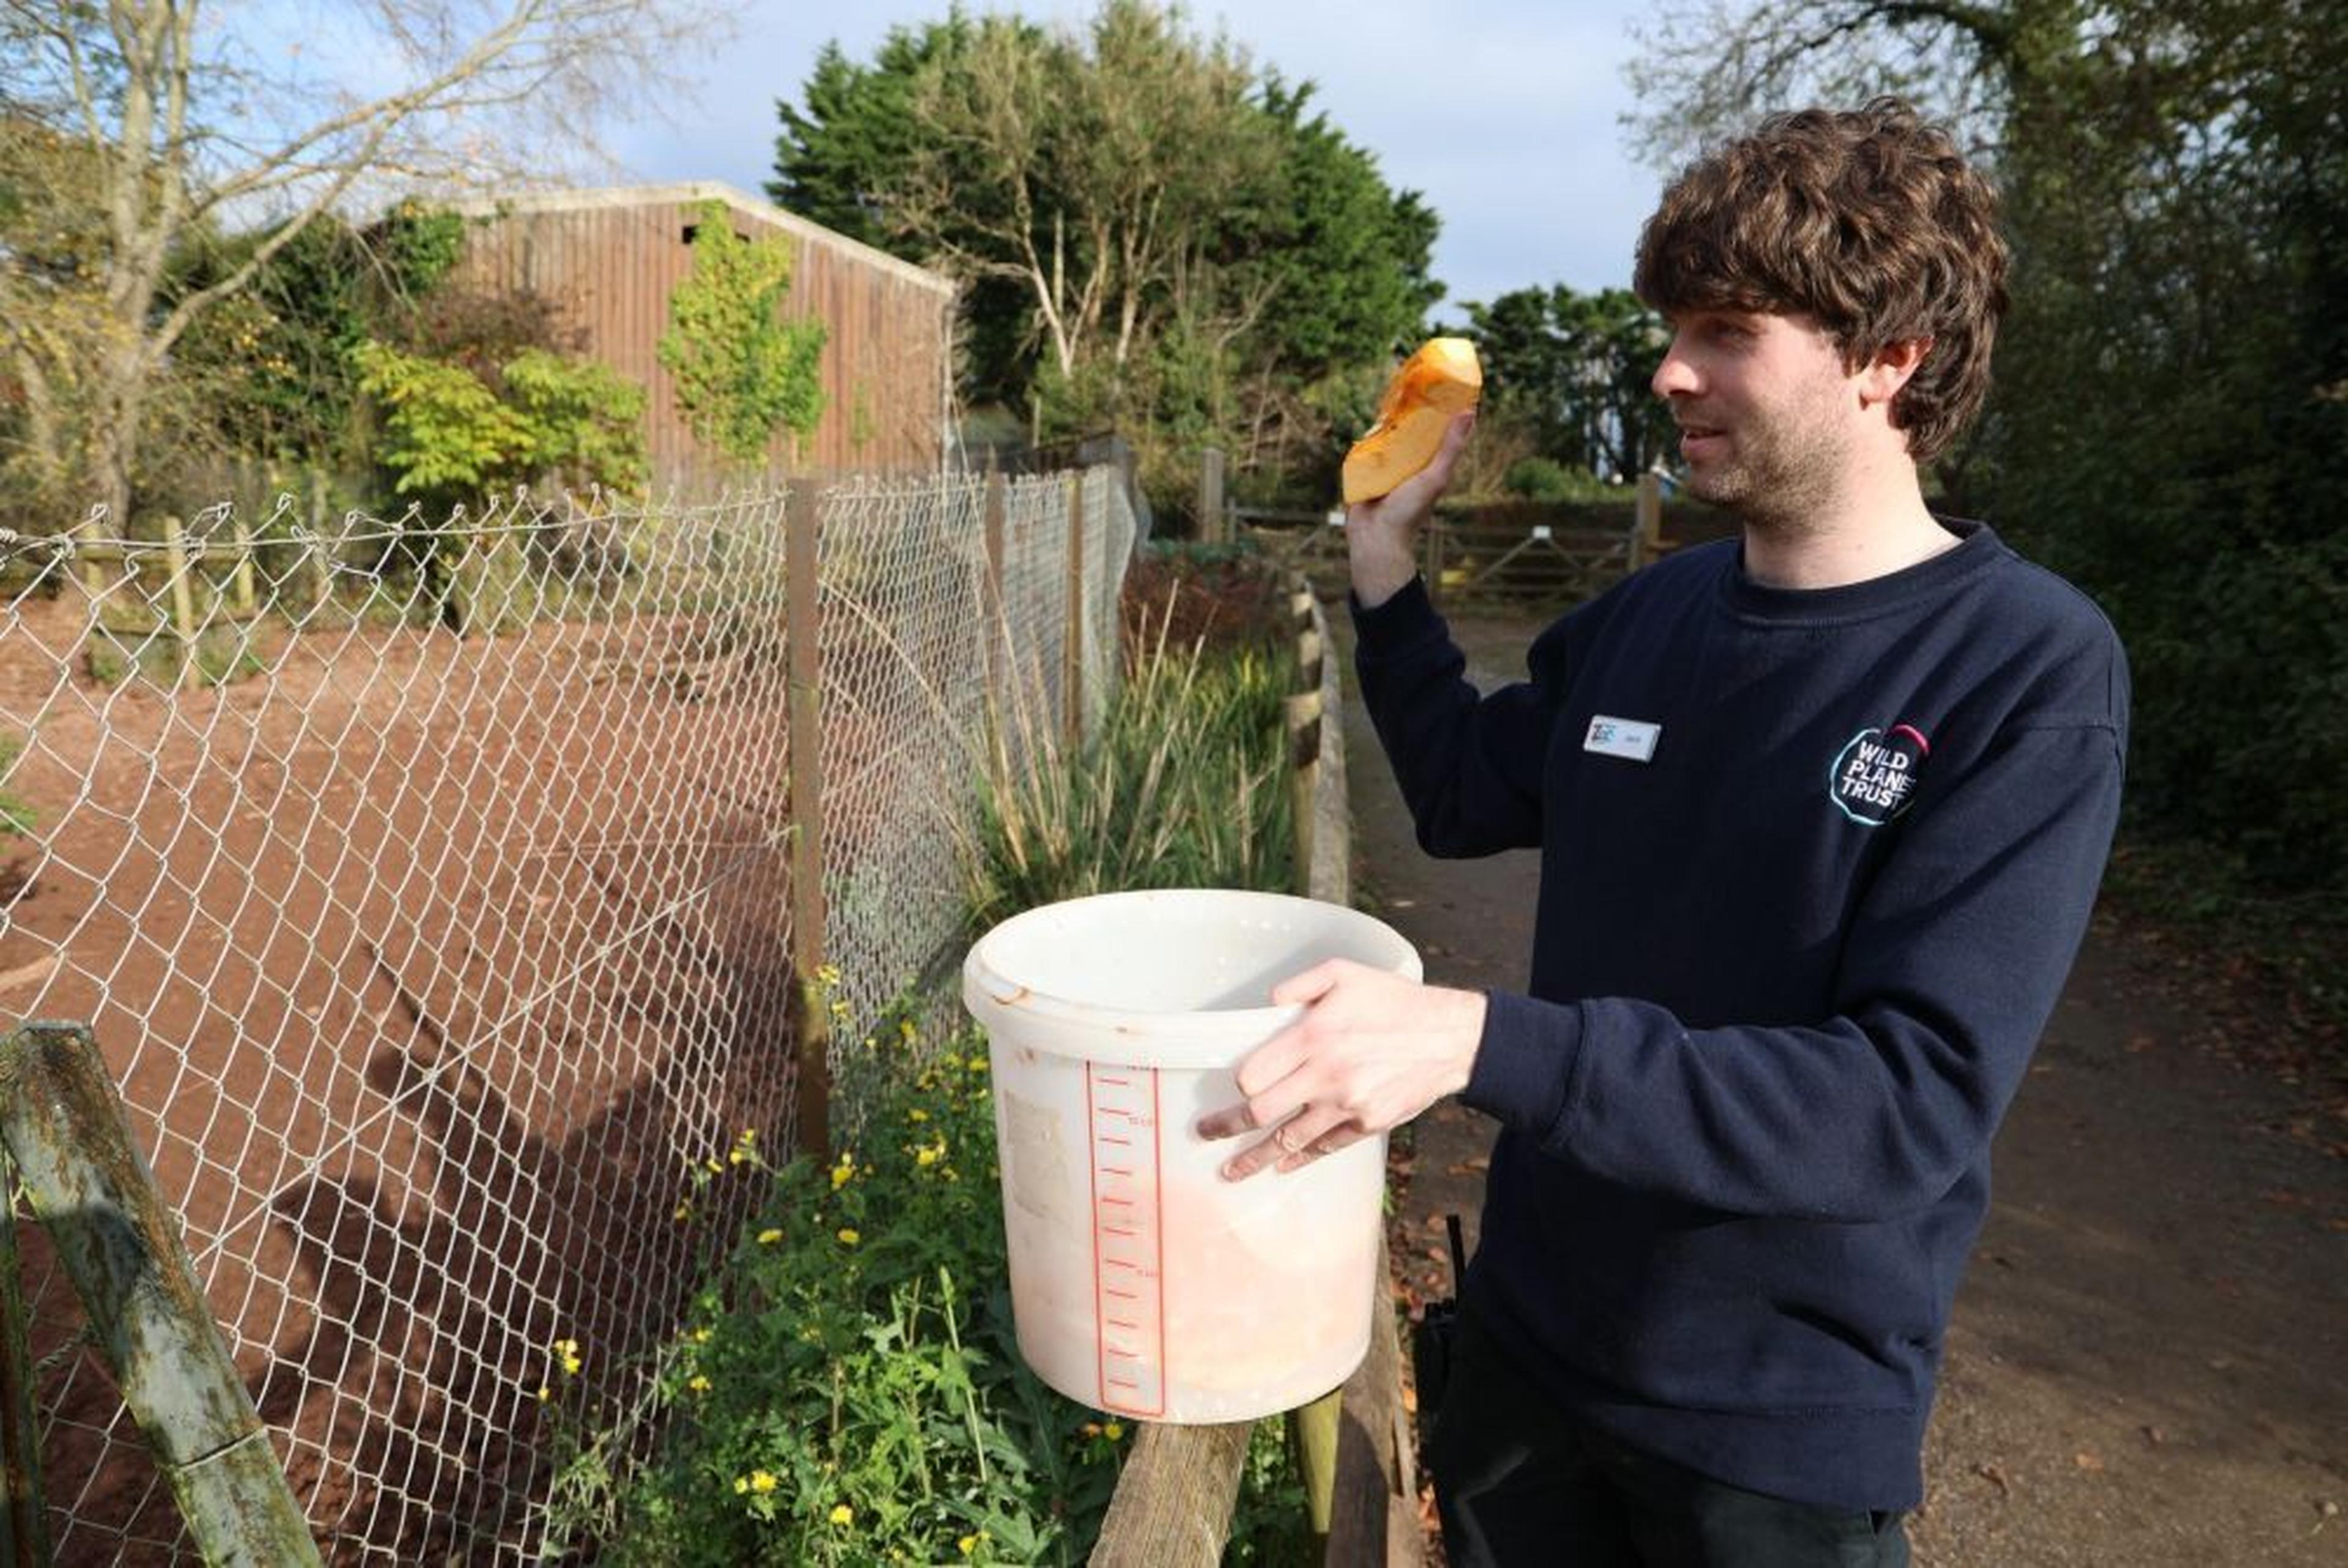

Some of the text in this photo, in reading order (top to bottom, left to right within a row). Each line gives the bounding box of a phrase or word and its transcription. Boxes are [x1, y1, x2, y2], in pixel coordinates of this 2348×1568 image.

[1858, 741, 1909, 770] WILD
[1847, 760, 1916, 792] PLANE
[1842, 776, 1904, 809] TRUST
